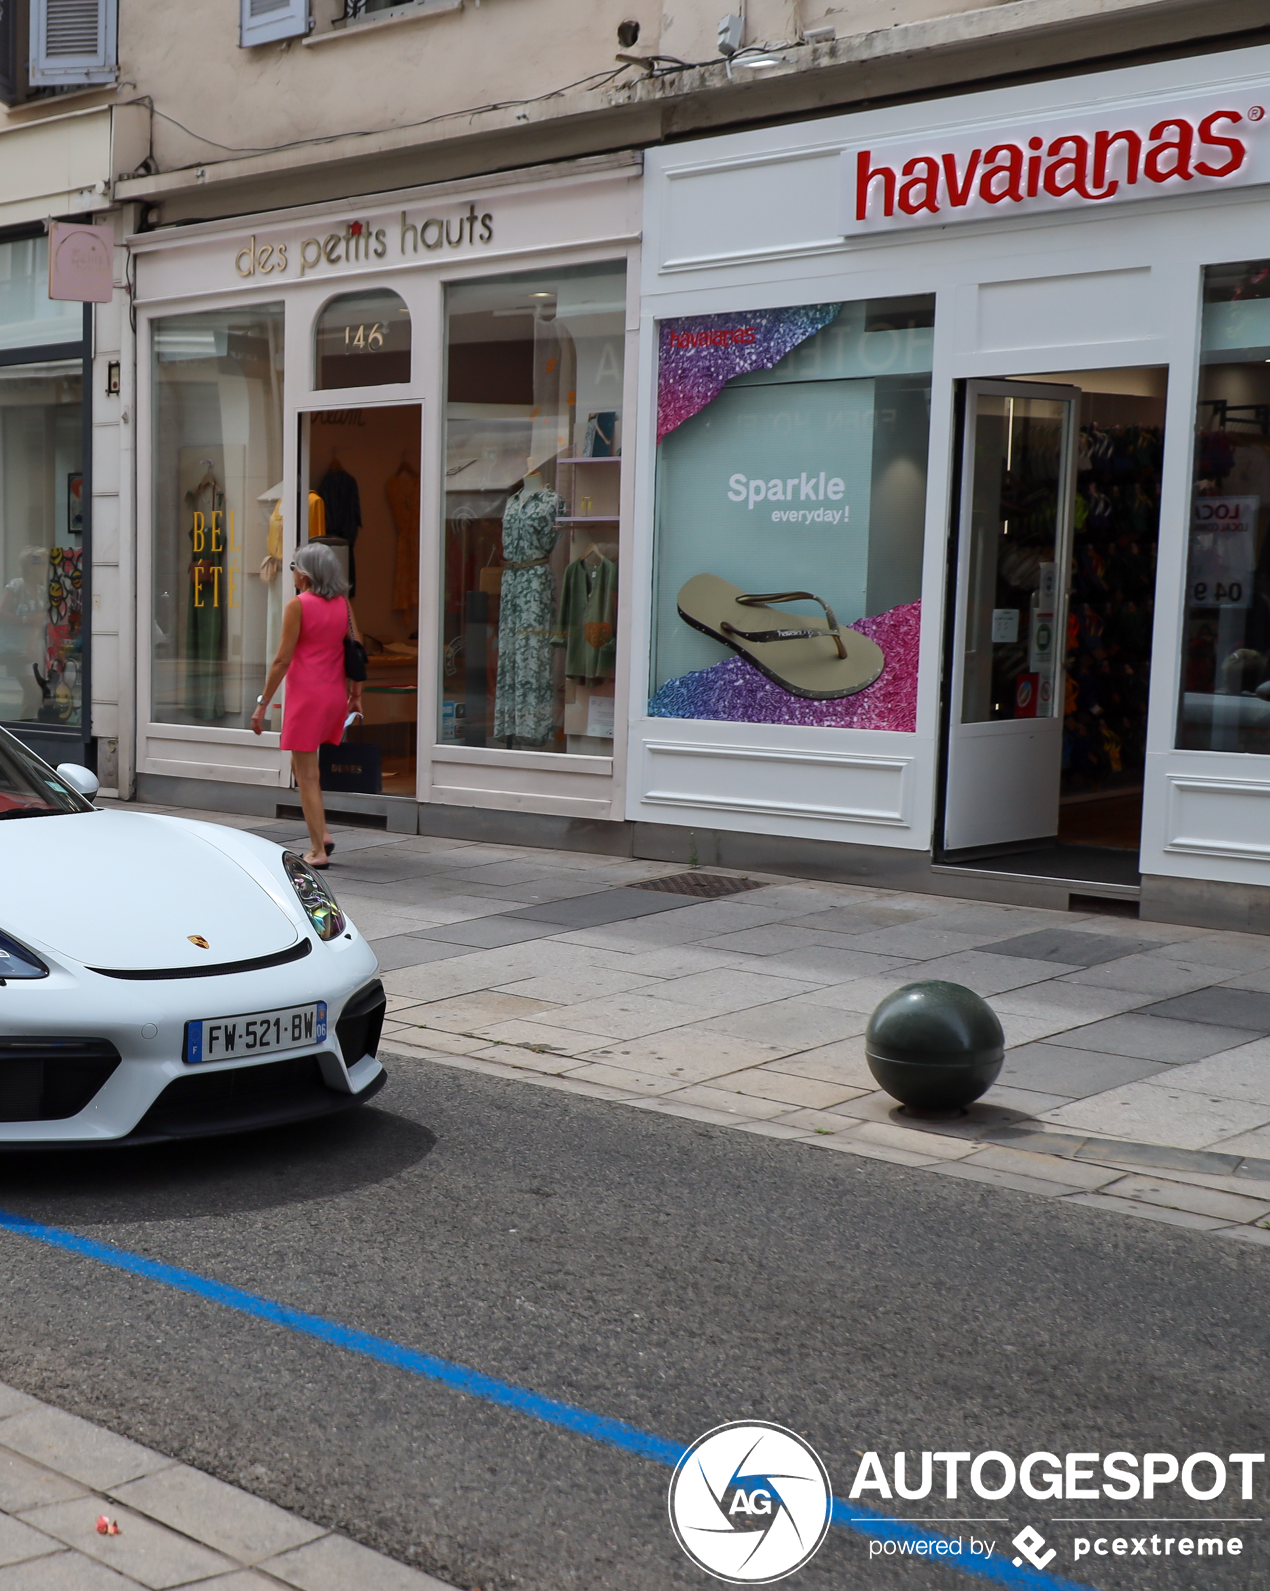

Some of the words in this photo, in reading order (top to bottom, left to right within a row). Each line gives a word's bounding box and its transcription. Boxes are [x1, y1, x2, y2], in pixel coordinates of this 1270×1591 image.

[235, 235, 288, 277] des
[300, 221, 387, 276] petits
[400, 205, 493, 254] hauts
[345, 323, 383, 355] 146
[670, 326, 755, 349] havaianas
[727, 471, 845, 509] Sparkle
[193, 510, 241, 552] BEL
[771, 505, 850, 525] everyday!
[193, 559, 240, 607] ÉTÉ
[317, 1023, 327, 1037] 06
[192, 1045, 197, 1054] F
